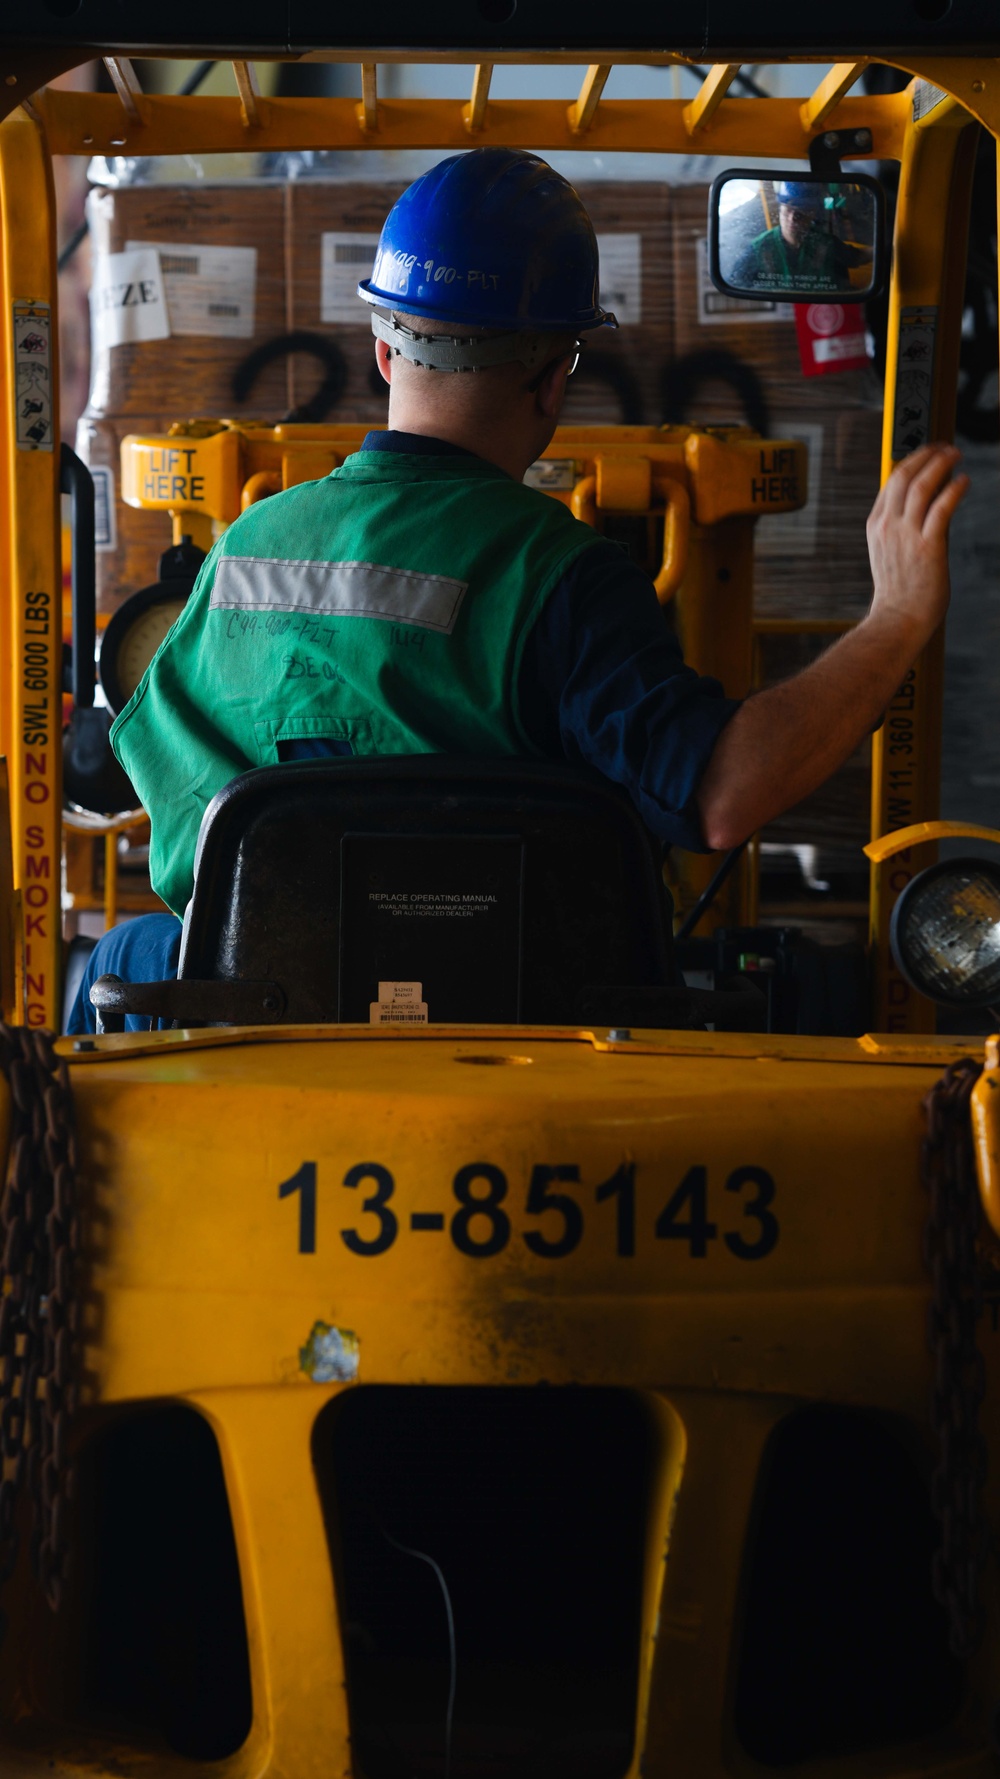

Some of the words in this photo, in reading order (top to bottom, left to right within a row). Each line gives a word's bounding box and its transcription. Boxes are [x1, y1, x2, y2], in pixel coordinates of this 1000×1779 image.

[794, 274, 818, 282] MIRROR
[819, 275, 832, 283] ARE
[150, 448, 197, 473] LIFT
[760, 449, 796, 473] LIFT
[144, 475, 205, 501] HERE
[25, 592, 51, 635] LBS
[24, 641, 48, 691] 6000
[23, 697, 48, 746] SWL
[24, 753, 50, 804] NO
[368, 893, 409, 902] REPLACE
[410, 894, 461, 902] OPERATING
[24, 825, 51, 1027] SMOKING
[279, 1161, 779, 1261] 13-85143
